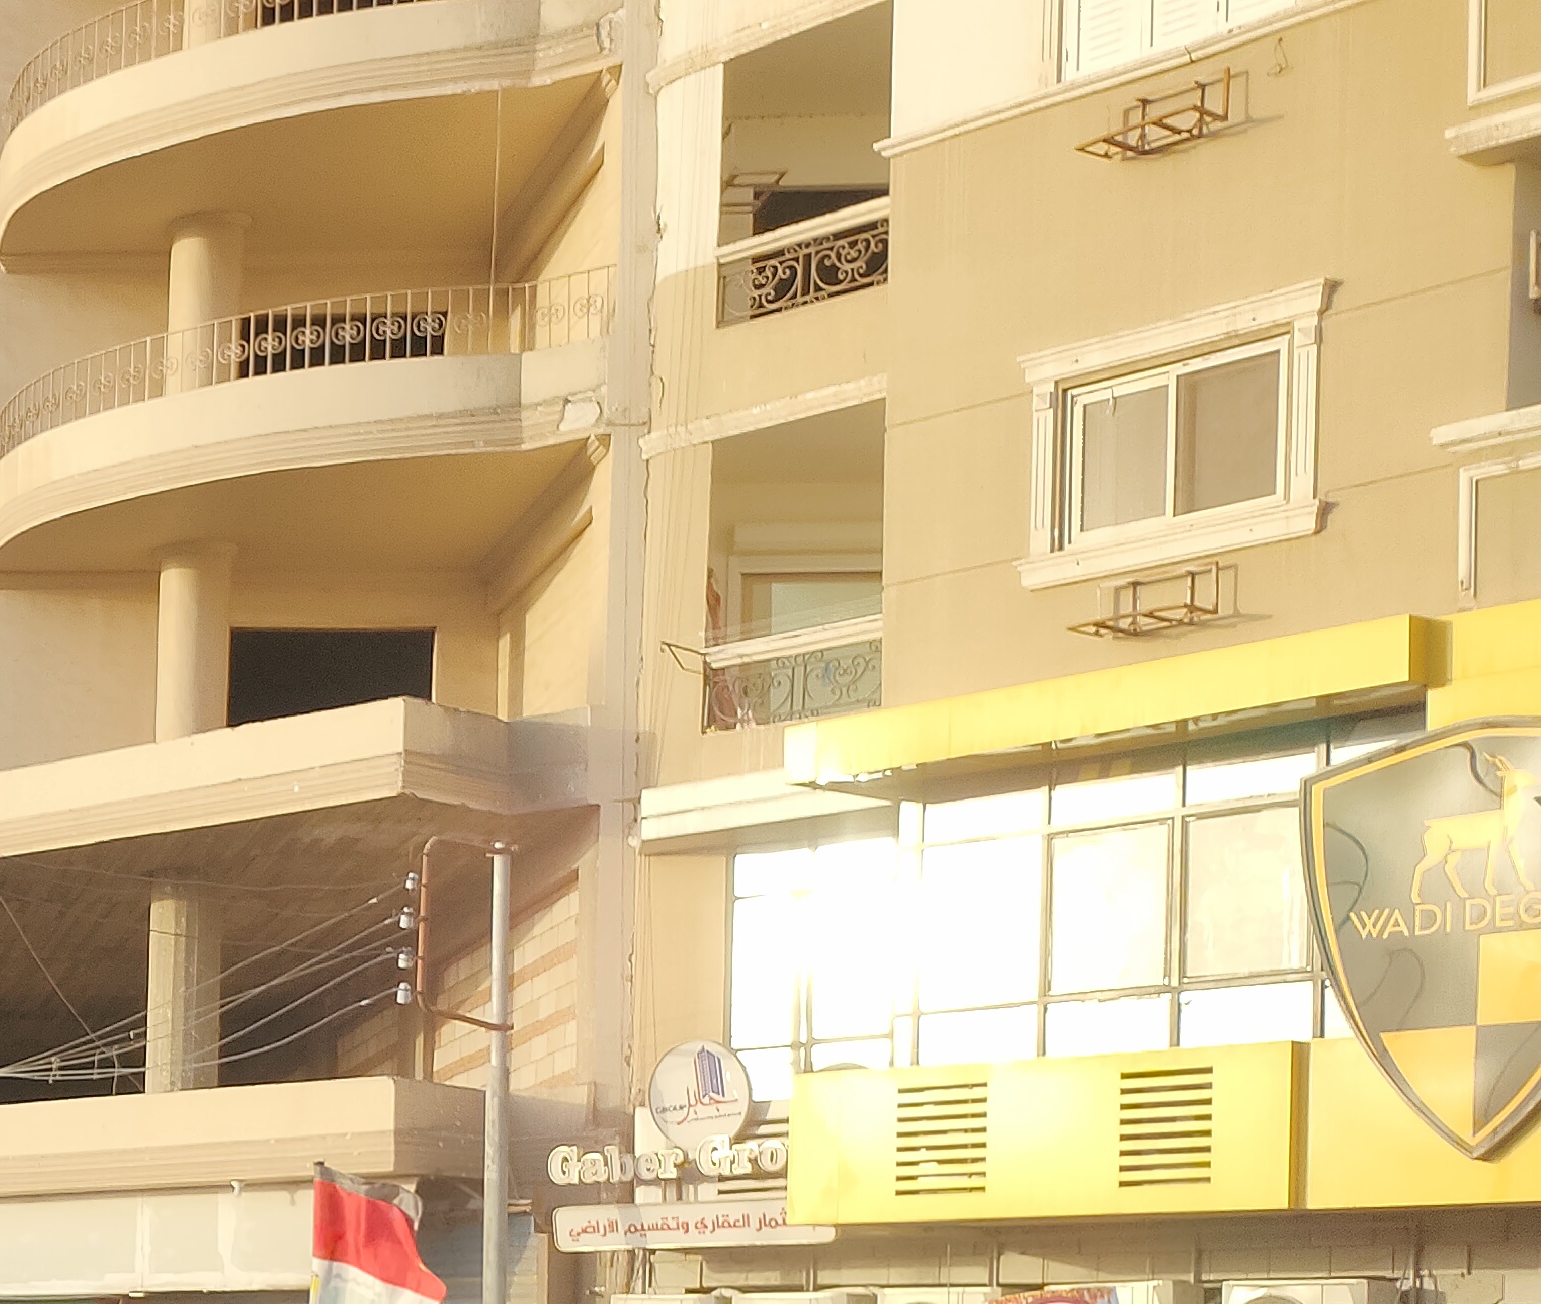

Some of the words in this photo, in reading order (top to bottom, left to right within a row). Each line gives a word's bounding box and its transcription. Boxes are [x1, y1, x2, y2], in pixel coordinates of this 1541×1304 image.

[1349, 901, 1452, 940] WADI
[547, 1143, 684, 1186] Gaber
[568, 1217, 619, 1242] الأراضي
[624, 1215, 689, 1237] وتقسيم
[694, 1212, 750, 1235] العقاري
